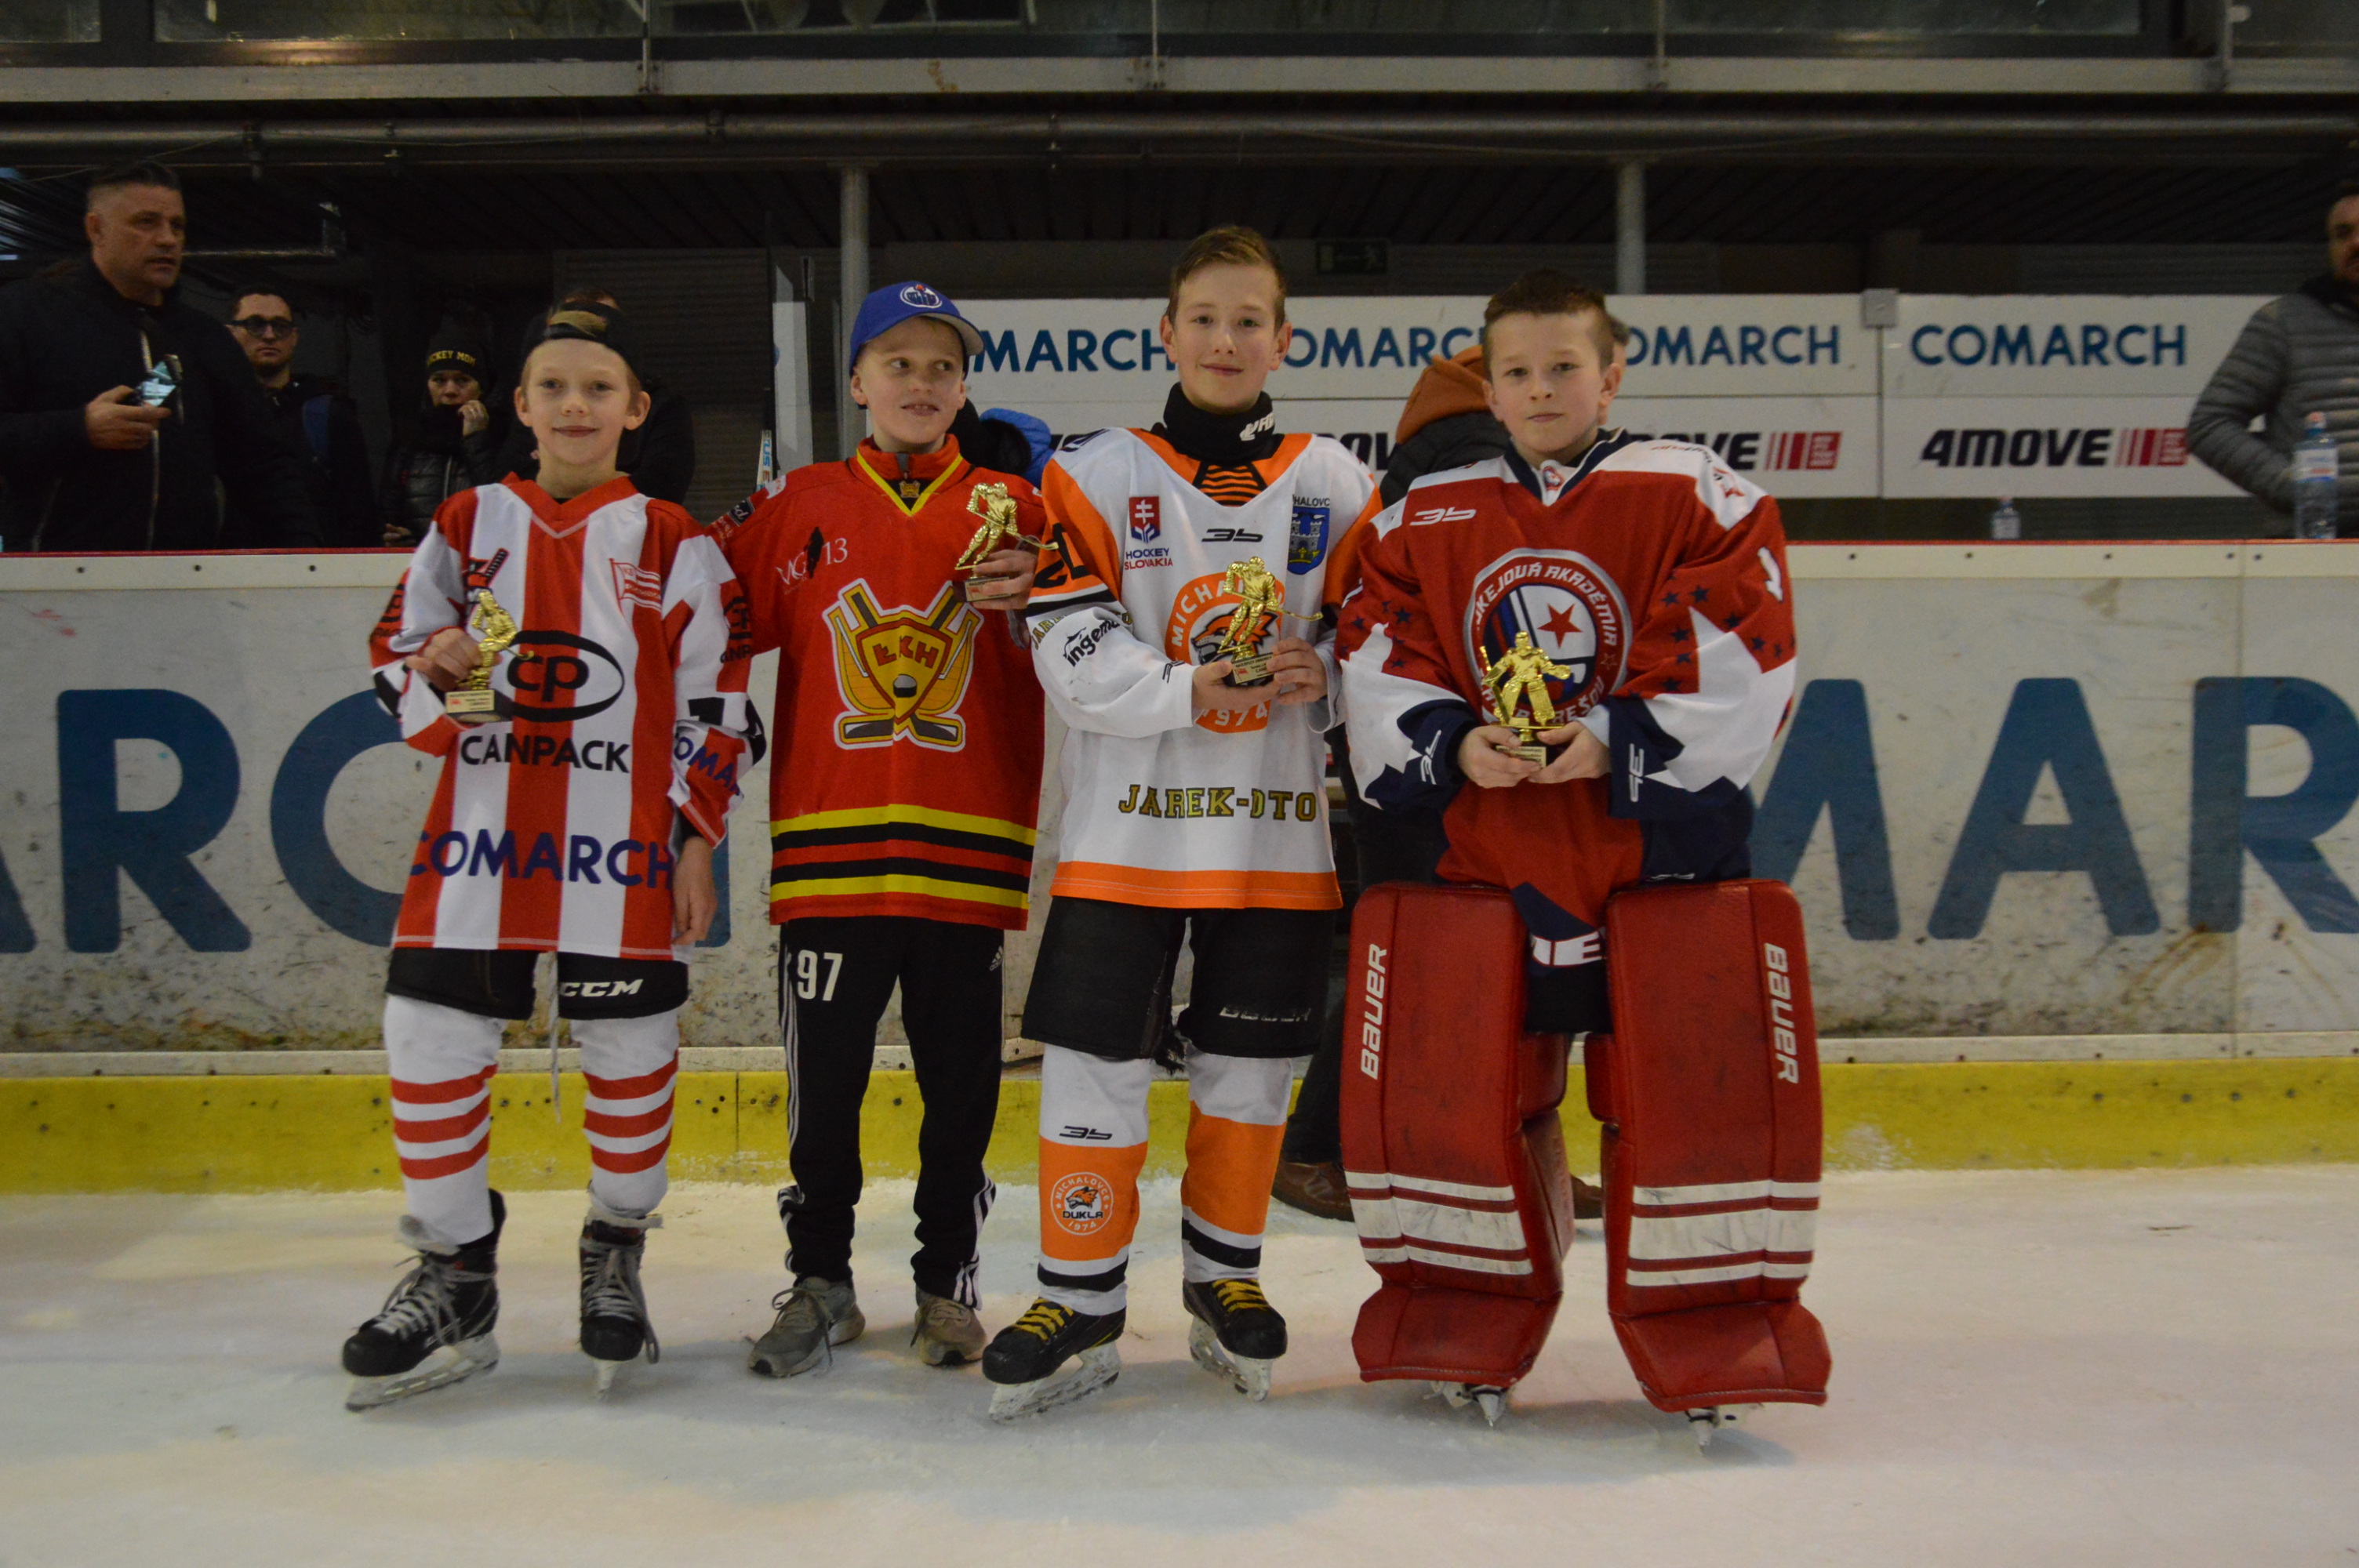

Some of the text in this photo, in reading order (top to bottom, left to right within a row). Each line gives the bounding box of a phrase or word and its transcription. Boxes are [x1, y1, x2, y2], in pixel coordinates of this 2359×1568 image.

[974, 328, 1176, 372] MARCH
[1284, 326, 1485, 368] OMARC
[1627, 325, 1840, 365] OMARCH
[1912, 324, 2186, 366] COMARCH
[1921, 428, 2111, 467] 4MOVE
[1292, 494, 1331, 506] HALOVC
[823, 537, 849, 566] 13
[1125, 557, 1173, 570] SLOVAKIA
[1126, 547, 1170, 559] HOCKEY
[1551, 675, 1605, 724] REŠOV
[461, 733, 631, 773] CANPACK
[1119, 785, 1317, 822] JAREK-DTO
[559, 978, 644, 997] CCM
[795, 949, 843, 1001] 97
[1056, 1175, 1110, 1201] MICHALOVCE
[1063, 1210, 1103, 1219] DUKLA
[1068, 1221, 1097, 1232] 1974
